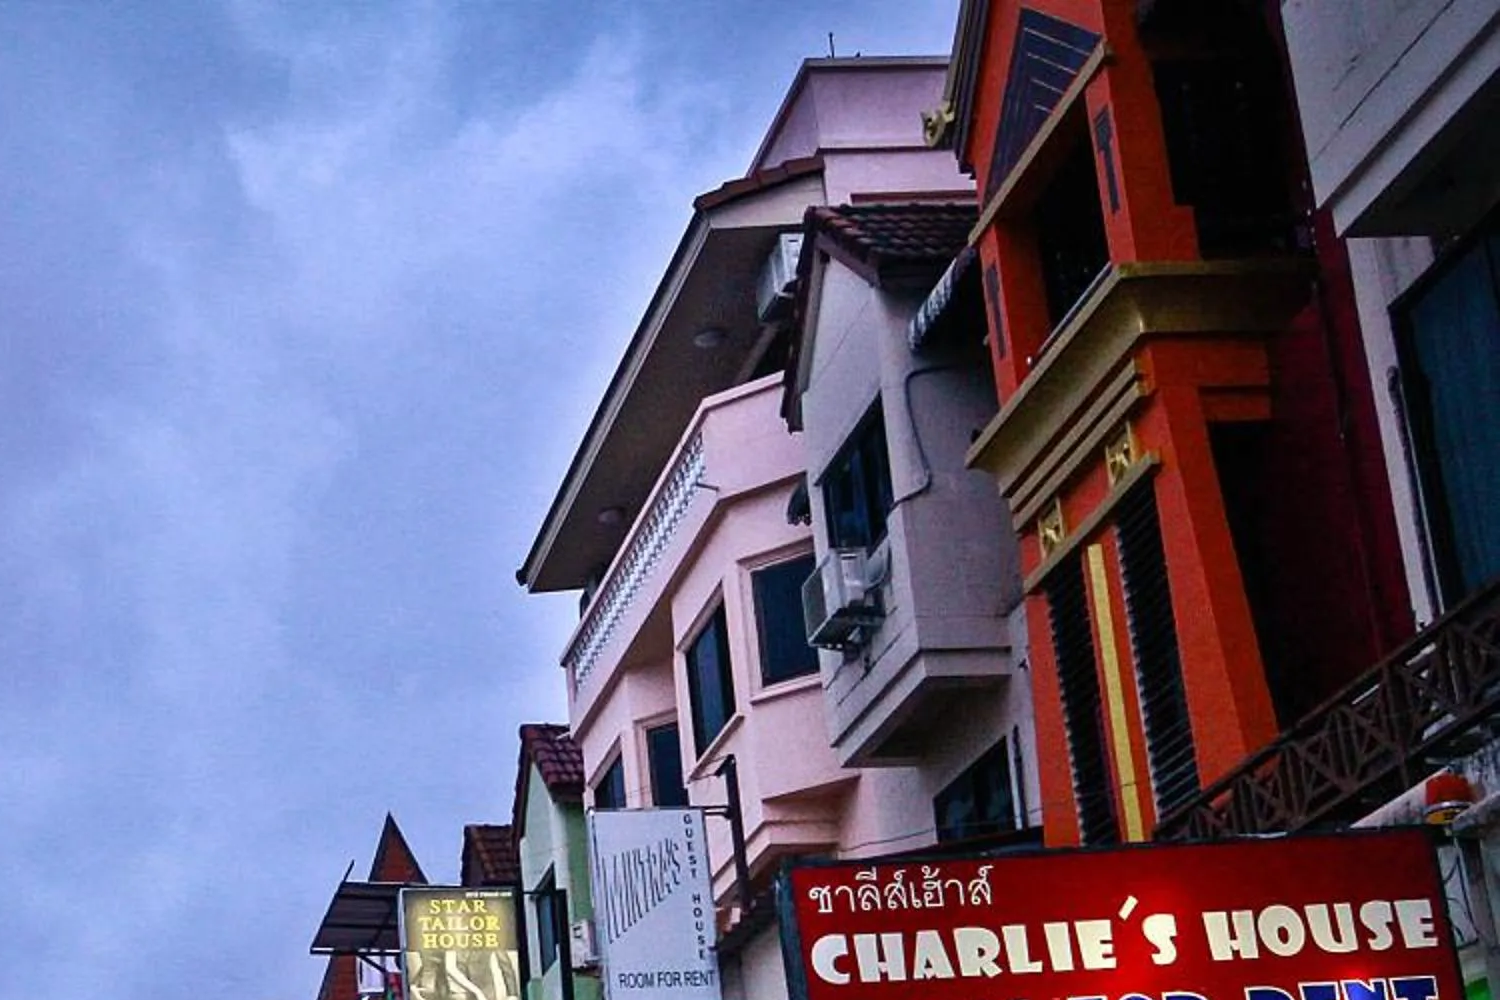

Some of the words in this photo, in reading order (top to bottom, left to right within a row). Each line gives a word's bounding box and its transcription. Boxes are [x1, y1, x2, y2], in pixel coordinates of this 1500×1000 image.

[430, 900, 488, 914] STAR
[419, 915, 501, 932] TAILOR
[422, 932, 500, 949] HOUSE
[811, 896, 1177, 984] CHARLIE'S
[1202, 898, 1440, 963] HOUSE
[619, 973, 655, 989] ROOM
[657, 971, 681, 988] FOR
[684, 969, 716, 987] RENT
